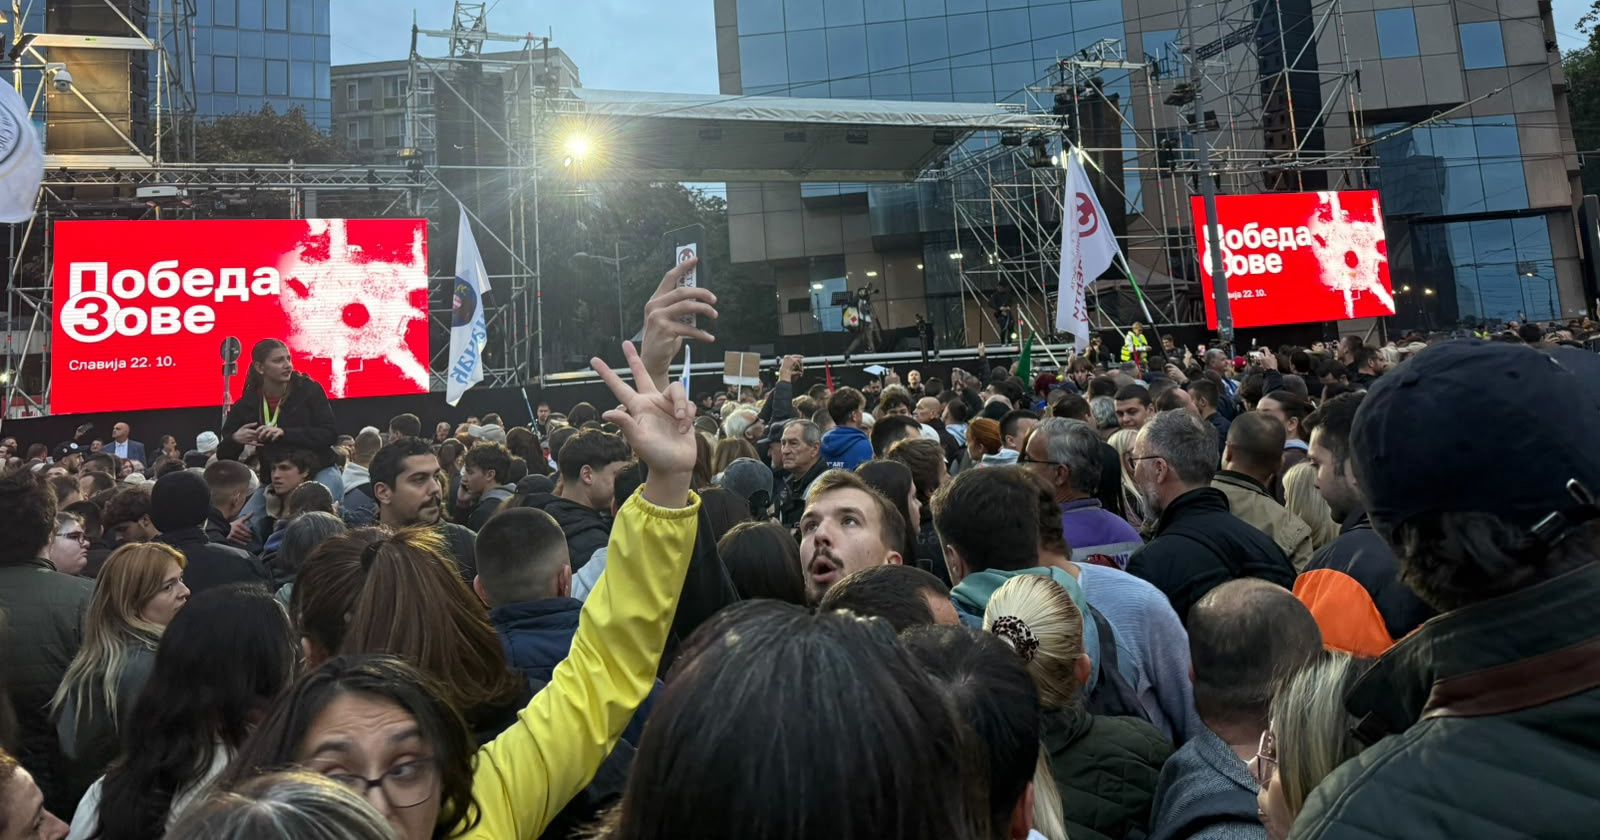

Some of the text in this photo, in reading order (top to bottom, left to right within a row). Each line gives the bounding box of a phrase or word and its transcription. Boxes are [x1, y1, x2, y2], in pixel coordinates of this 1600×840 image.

[69, 260, 281, 302] Победа
[1243, 290, 1255, 298] 22.
[1255, 289, 1267, 297] 10.
[60, 291, 216, 343] Зове
[69, 355, 176, 372] Славија 22. 10.
